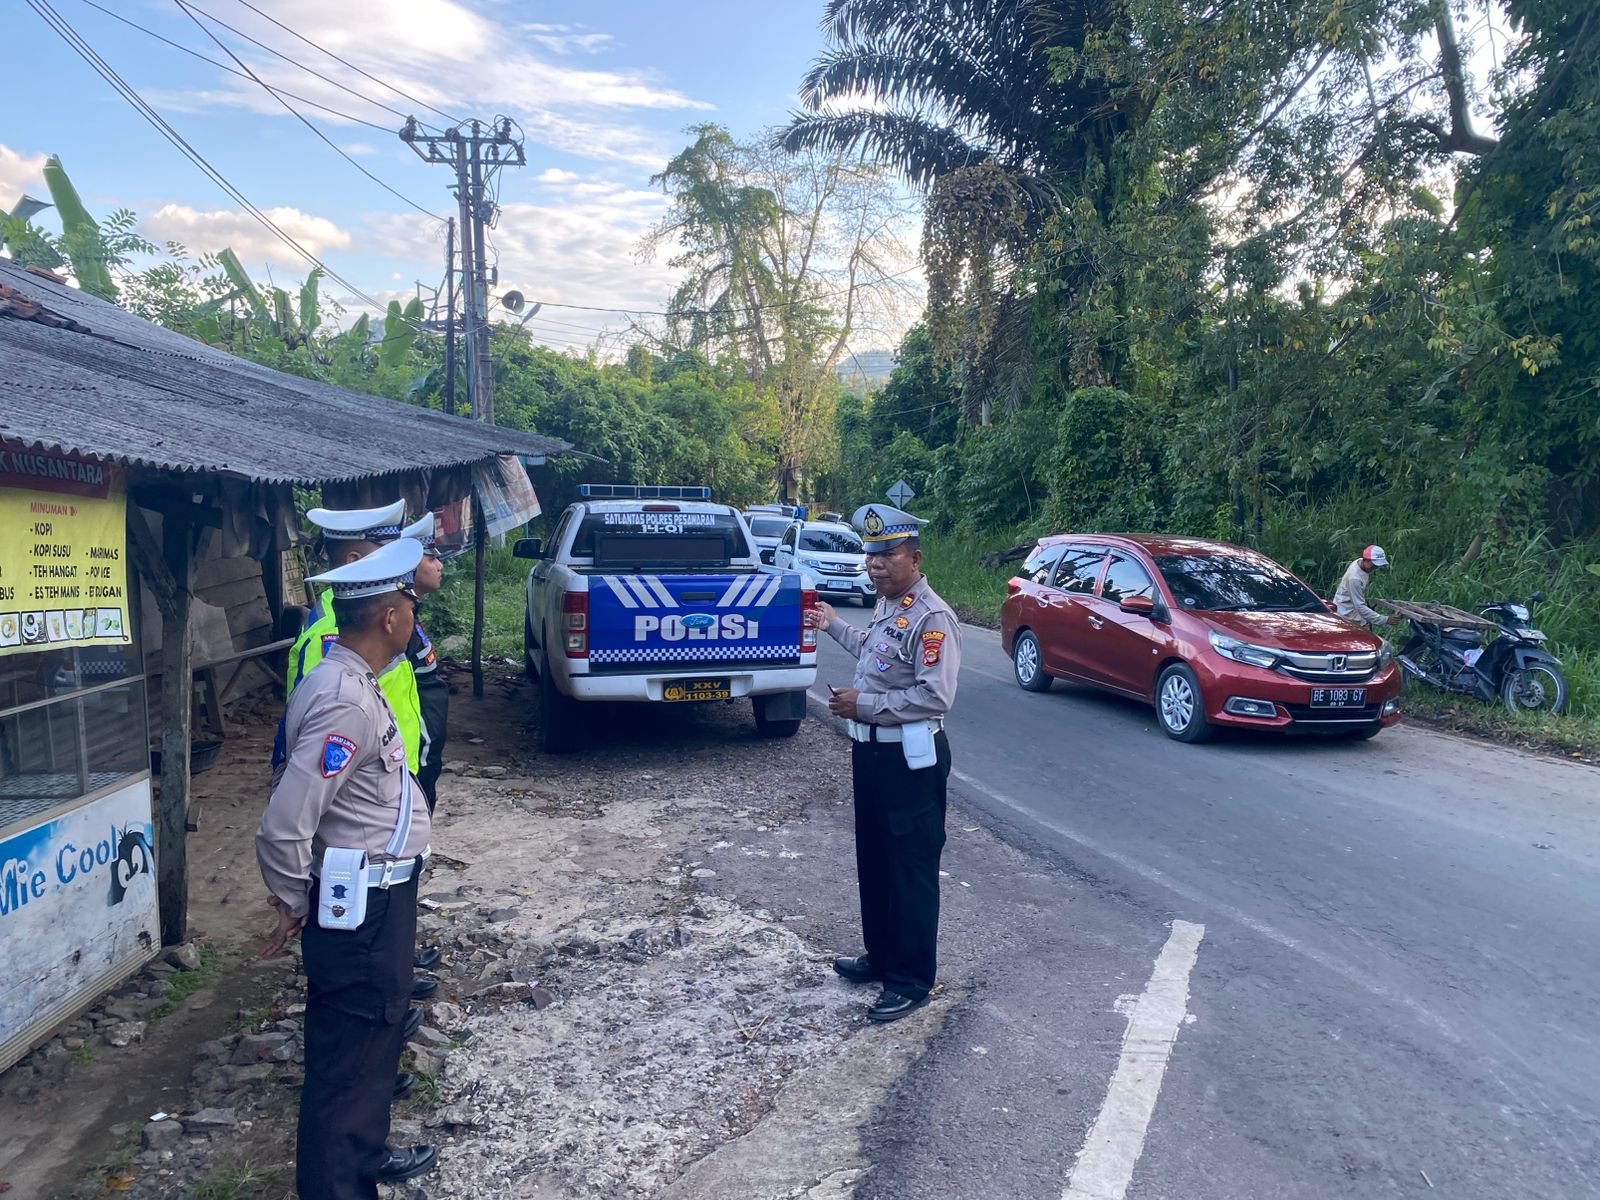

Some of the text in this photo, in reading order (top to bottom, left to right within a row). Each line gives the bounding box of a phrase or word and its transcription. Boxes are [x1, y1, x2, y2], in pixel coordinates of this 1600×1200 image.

[11, 452, 104, 485] NUSANTARA
[30, 502, 68, 515] MINUMAN
[604, 513, 715, 526] SATLANTAS POLRES PESAWARAN
[34, 522, 53, 536] KOPI
[33, 543, 72, 558] KOPI SUSU
[33, 564, 78, 578] TEH HANGAT
[35, 585, 80, 600] ES TEH MANIS
[693, 682, 722, 690] XXV
[686, 691, 730, 701] 1103-39
[1313, 689, 1364, 702] BE 1083 GY
[55, 823, 118, 884] Cool
